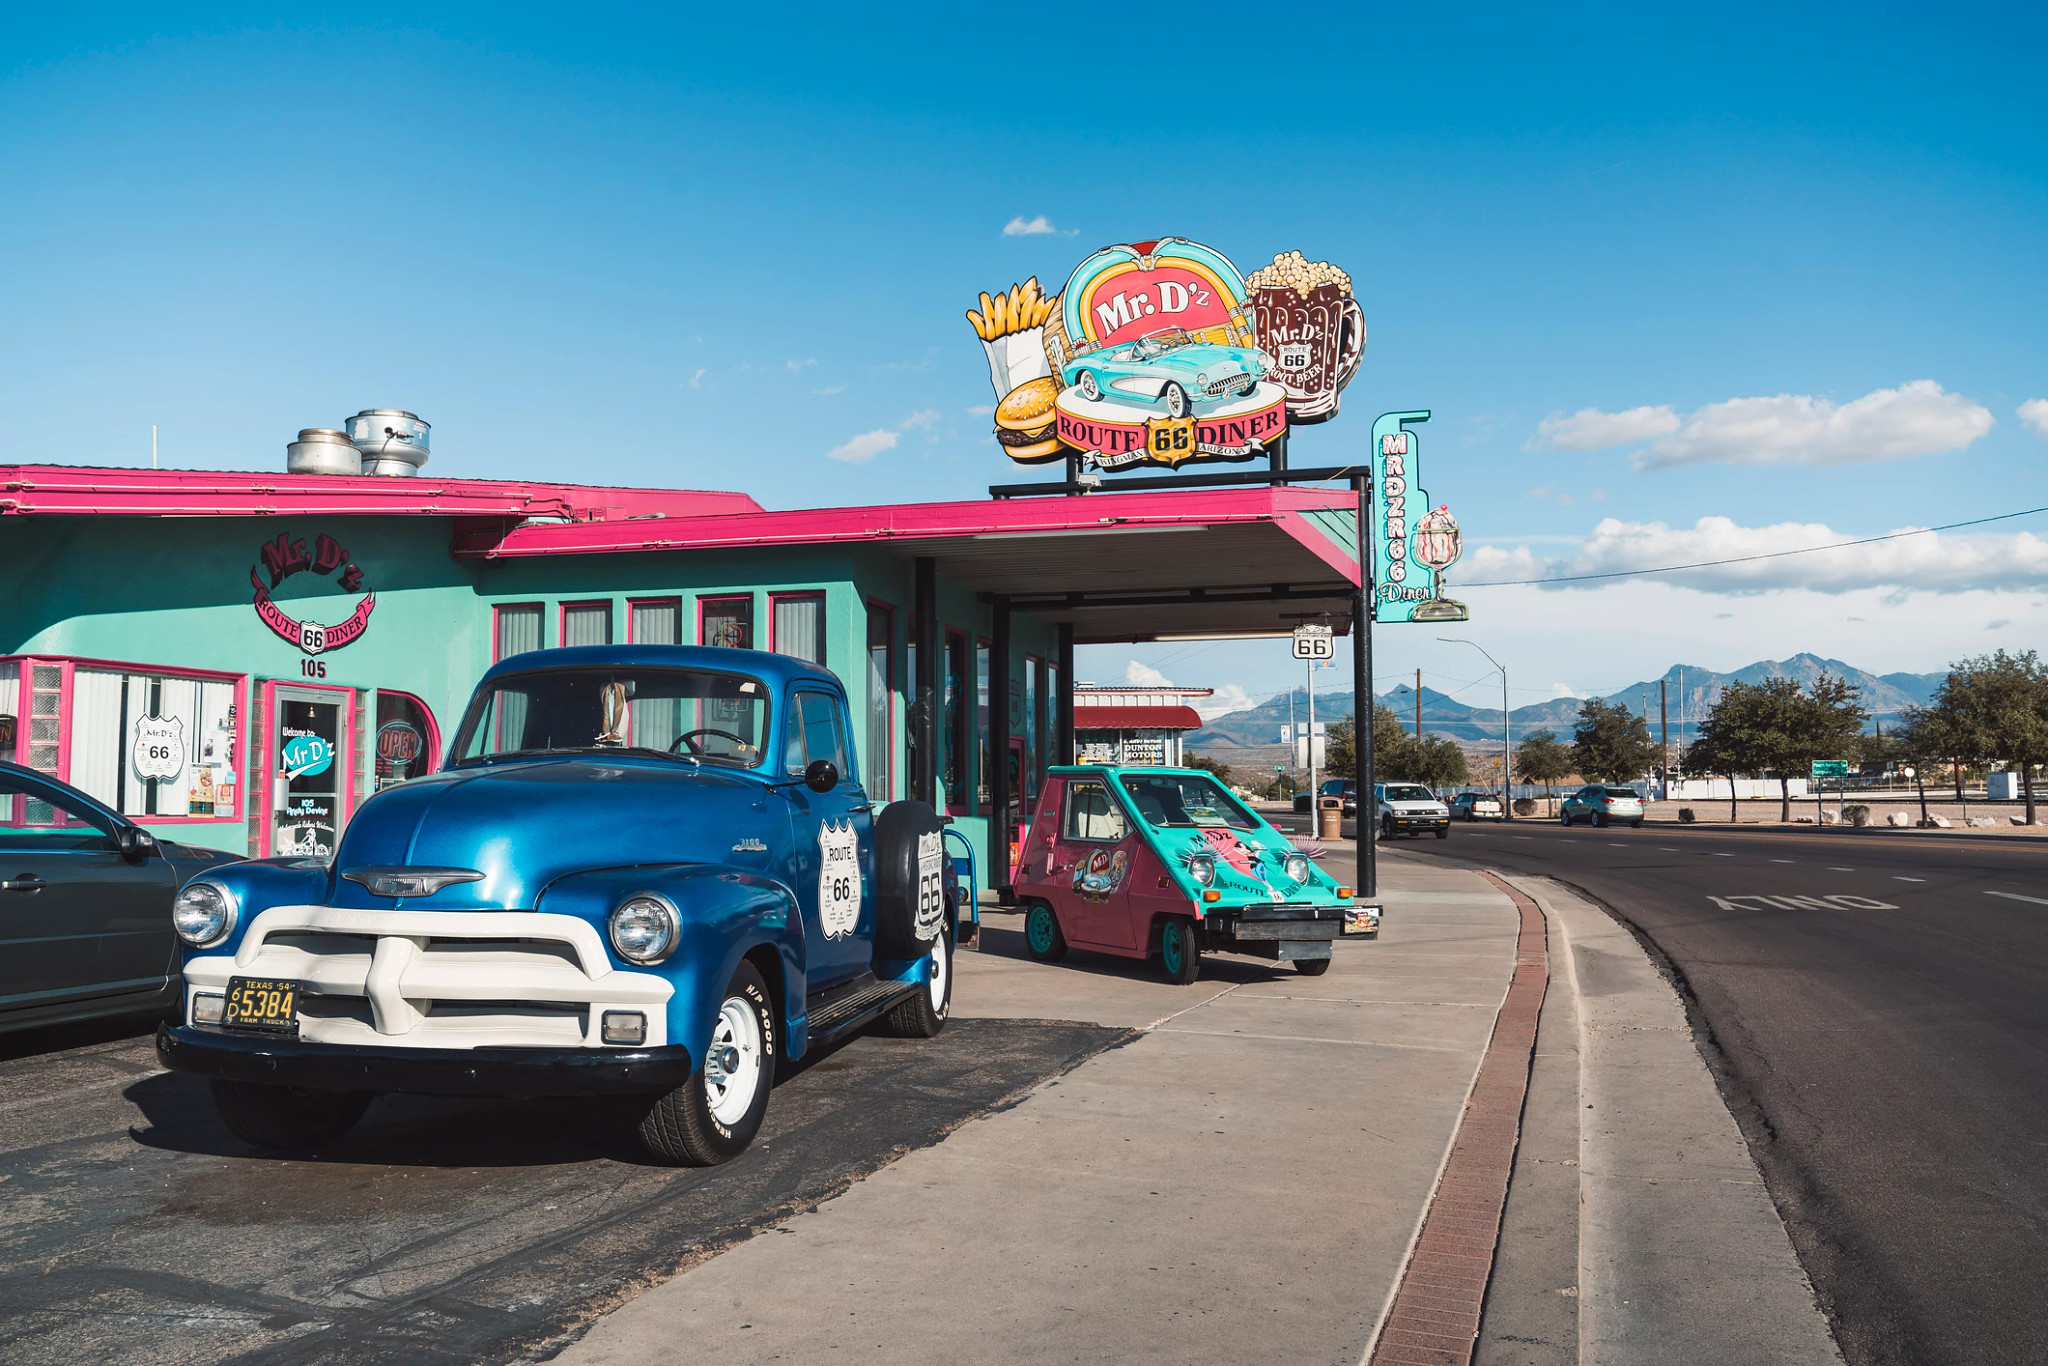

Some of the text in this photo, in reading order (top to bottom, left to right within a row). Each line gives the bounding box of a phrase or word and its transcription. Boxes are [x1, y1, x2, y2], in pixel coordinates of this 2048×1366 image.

[1093, 281, 1210, 339] Mr. D'z
[1270, 324, 1324, 346] Mr. D'z
[1284, 355, 1305, 366] 66
[1270, 364, 1324, 383] ROOT BEER
[1060, 410, 1278, 451] ROUTE 66 DINER
[1100, 443, 1246, 466] KINGMAN ARIZONA
[261, 532, 312, 589] Mr.
[1380, 582, 1432, 602] Diner
[258, 596, 363, 648] ROUTE 66 DINER
[1298, 640, 1326, 654] 66
[300, 658, 326, 678] 105
[282, 726, 306, 739] Welcome
[150, 746, 169, 759] 66
[282, 738, 335, 770] Mr D'z
[381, 728, 417, 760] OPEN
[286, 806, 328, 816] Andy Devine
[302, 799, 314, 807] 105
[829, 846, 851, 861] ROUTE
[834, 877, 850, 901] 66
[921, 872, 940, 915] 66
[1229, 882, 1268, 898] ROUTE
[232, 987, 241, 1001] 6
[246, 981, 289, 990] TEXAS '54
[227, 1003, 238, 1017] D
[240, 990, 294, 1018] 5384
[746, 984, 773, 1055] H/P 4000
